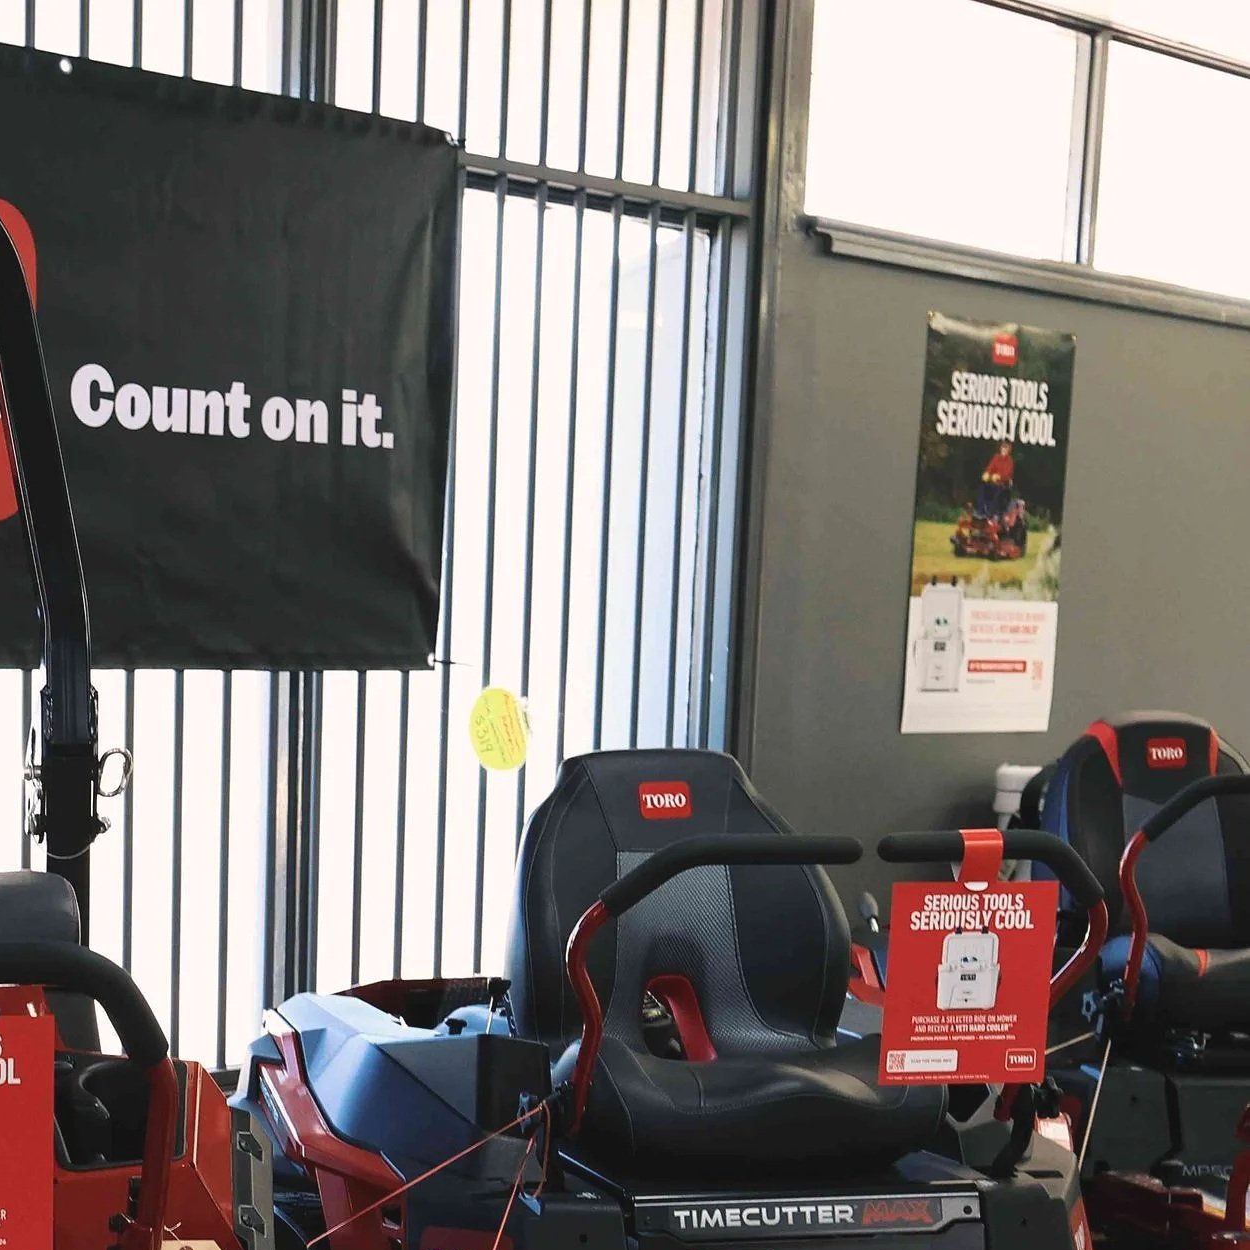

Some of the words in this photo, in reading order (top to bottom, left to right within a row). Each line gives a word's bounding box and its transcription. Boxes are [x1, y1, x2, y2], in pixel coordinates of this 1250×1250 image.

[950, 370, 1008, 406] SERIOUS
[1009, 378, 1049, 411] TOOLS
[71, 363, 250, 438] Count
[262, 392, 327, 445] on
[341, 389, 395, 449] it.
[936, 400, 1019, 442] SERIOUSLY
[1019, 411, 1056, 447] COOL
[1150, 747, 1183, 760] TORO
[642, 793, 686, 808] TORO
[924, 894, 980, 911] SERIOUS
[982, 893, 1024, 910] TOOLS
[910, 911, 992, 931] SERIOUSLY
[995, 910, 1034, 929] COOL
[911, 1015, 939, 1024] PURCHASE
[915, 1024, 926, 1033] AND
[955, 1024, 968, 1032] YETI
[969, 1024, 986, 1032] HARD
[1008, 1055, 1033, 1065] TORO
[674, 1205, 855, 1229] TIMECUTTER
[862, 1200, 934, 1225] MAX
